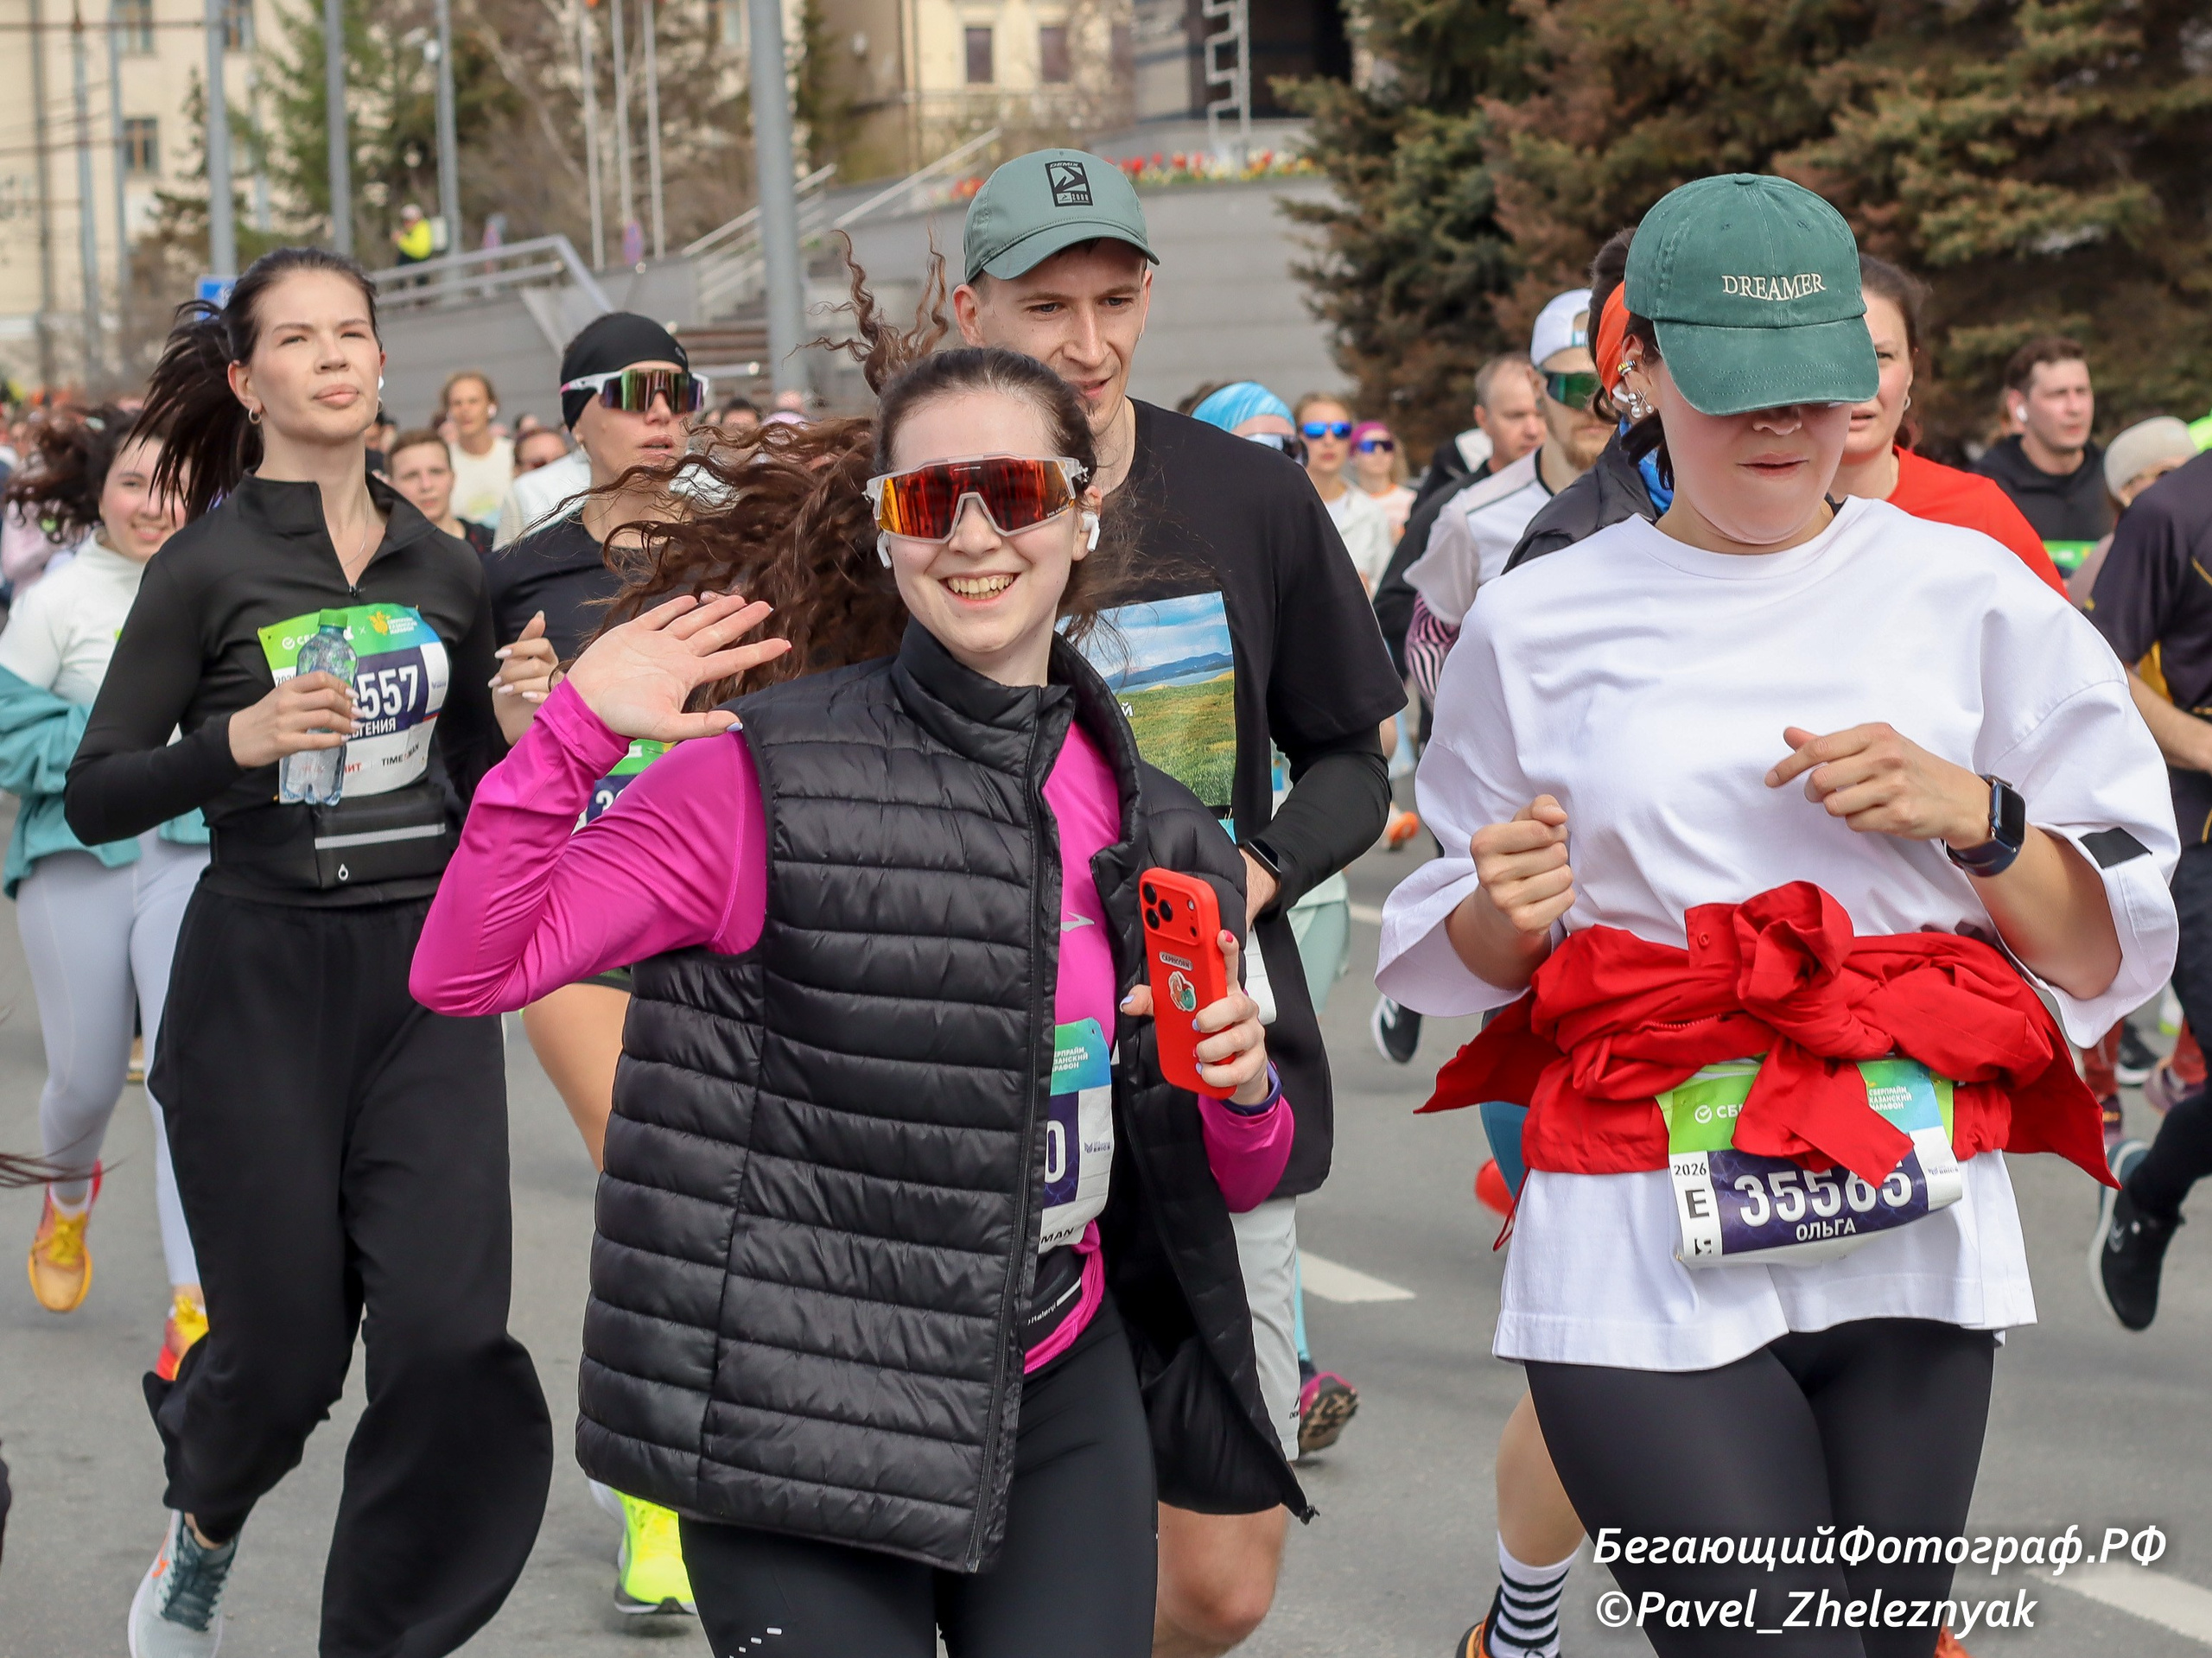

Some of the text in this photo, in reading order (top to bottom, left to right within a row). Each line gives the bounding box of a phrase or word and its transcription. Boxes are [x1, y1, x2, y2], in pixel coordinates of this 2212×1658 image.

[1721, 273, 1827, 301] DREAMER
[353, 664, 418, 720] 557
[1054, 1046, 1085, 1058] ЕРПРАЙМ
[1054, 1051, 1089, 1064] ЗАНСКИЙ
[1869, 1092, 1912, 1103] КАЗАНСКИЙ
[1674, 1162, 1707, 1176] 2026
[1734, 1159, 1912, 1227] 35565
[1796, 1217, 1857, 1242] ОЛЬГА
